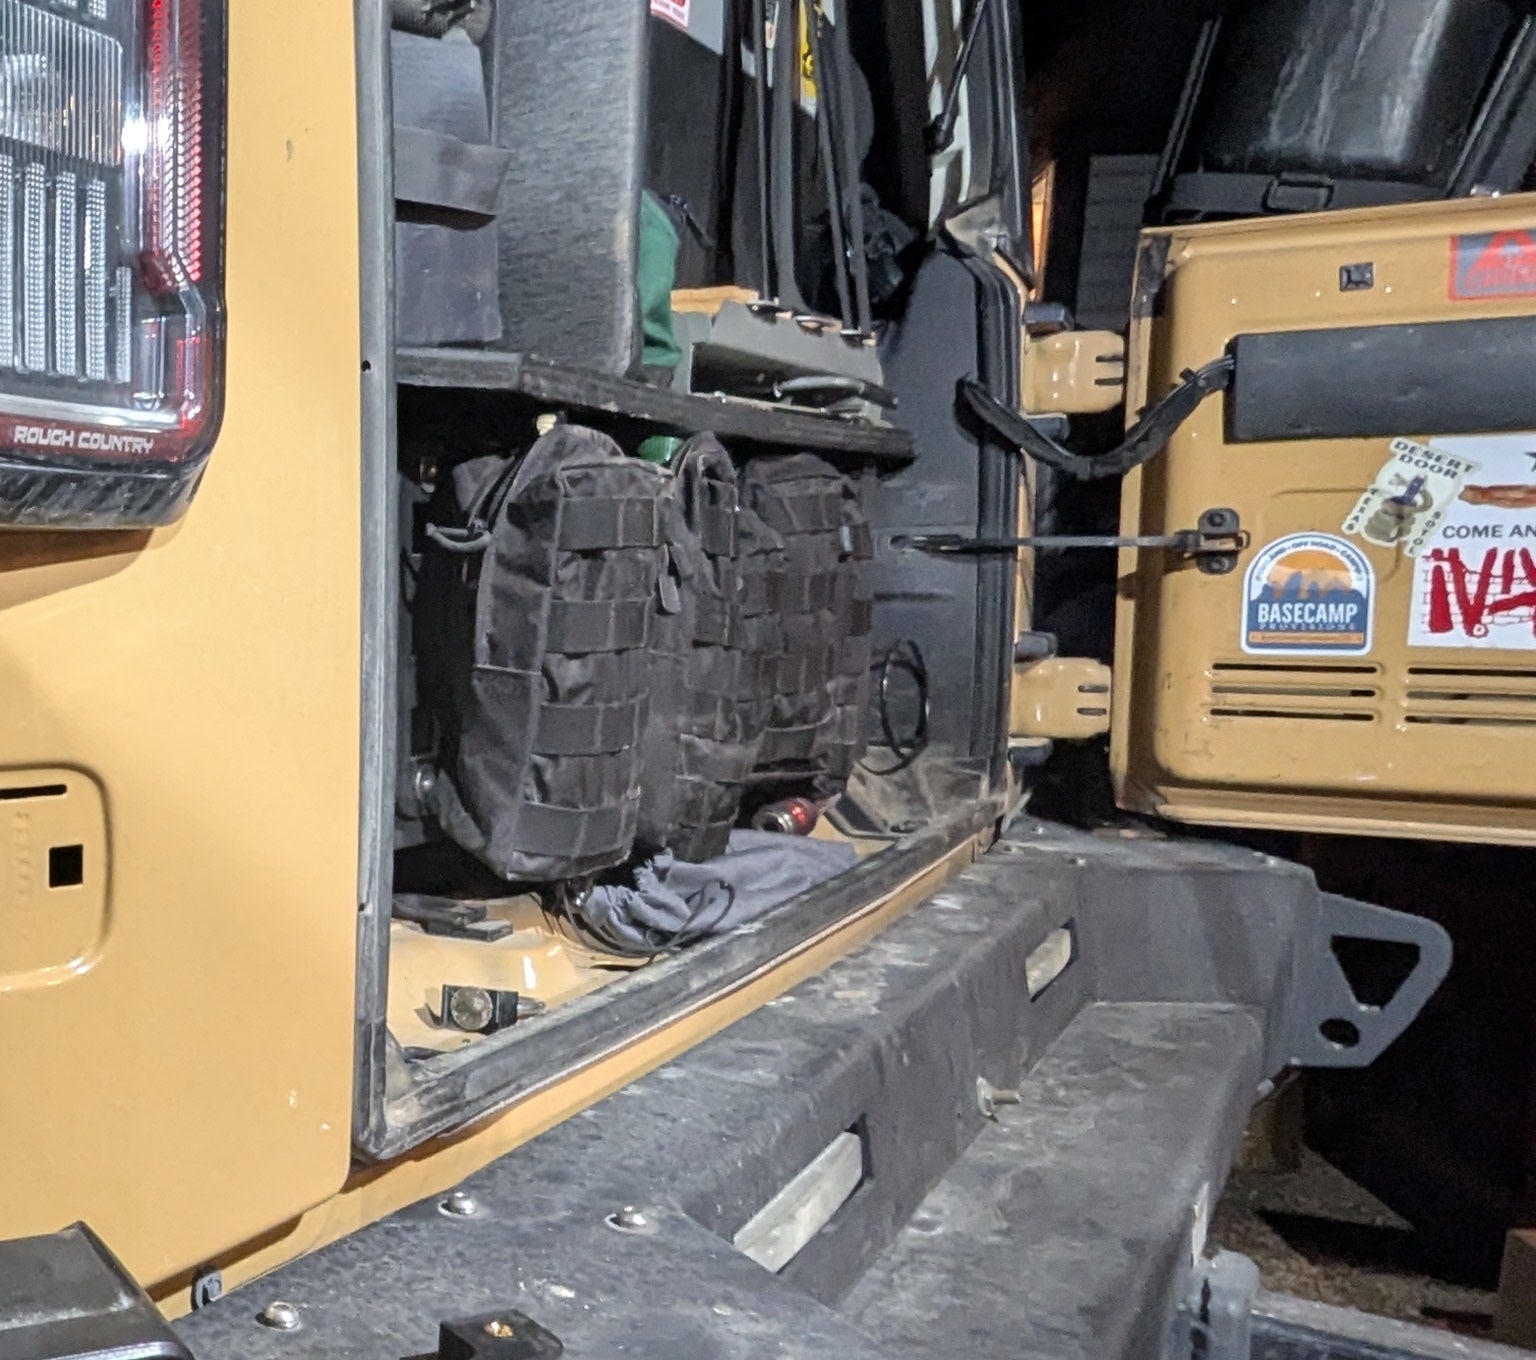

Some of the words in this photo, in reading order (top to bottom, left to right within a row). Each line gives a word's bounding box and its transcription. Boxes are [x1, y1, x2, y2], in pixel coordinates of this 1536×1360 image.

[14, 425, 74, 448] ROUGH
[77, 431, 154, 455] COUNTRY
[1393, 440, 1475, 474] DESERT
[1398, 453, 1459, 480] DOOR
[1442, 524, 1504, 539] COME
[1257, 602, 1359, 624] BASECAMP
